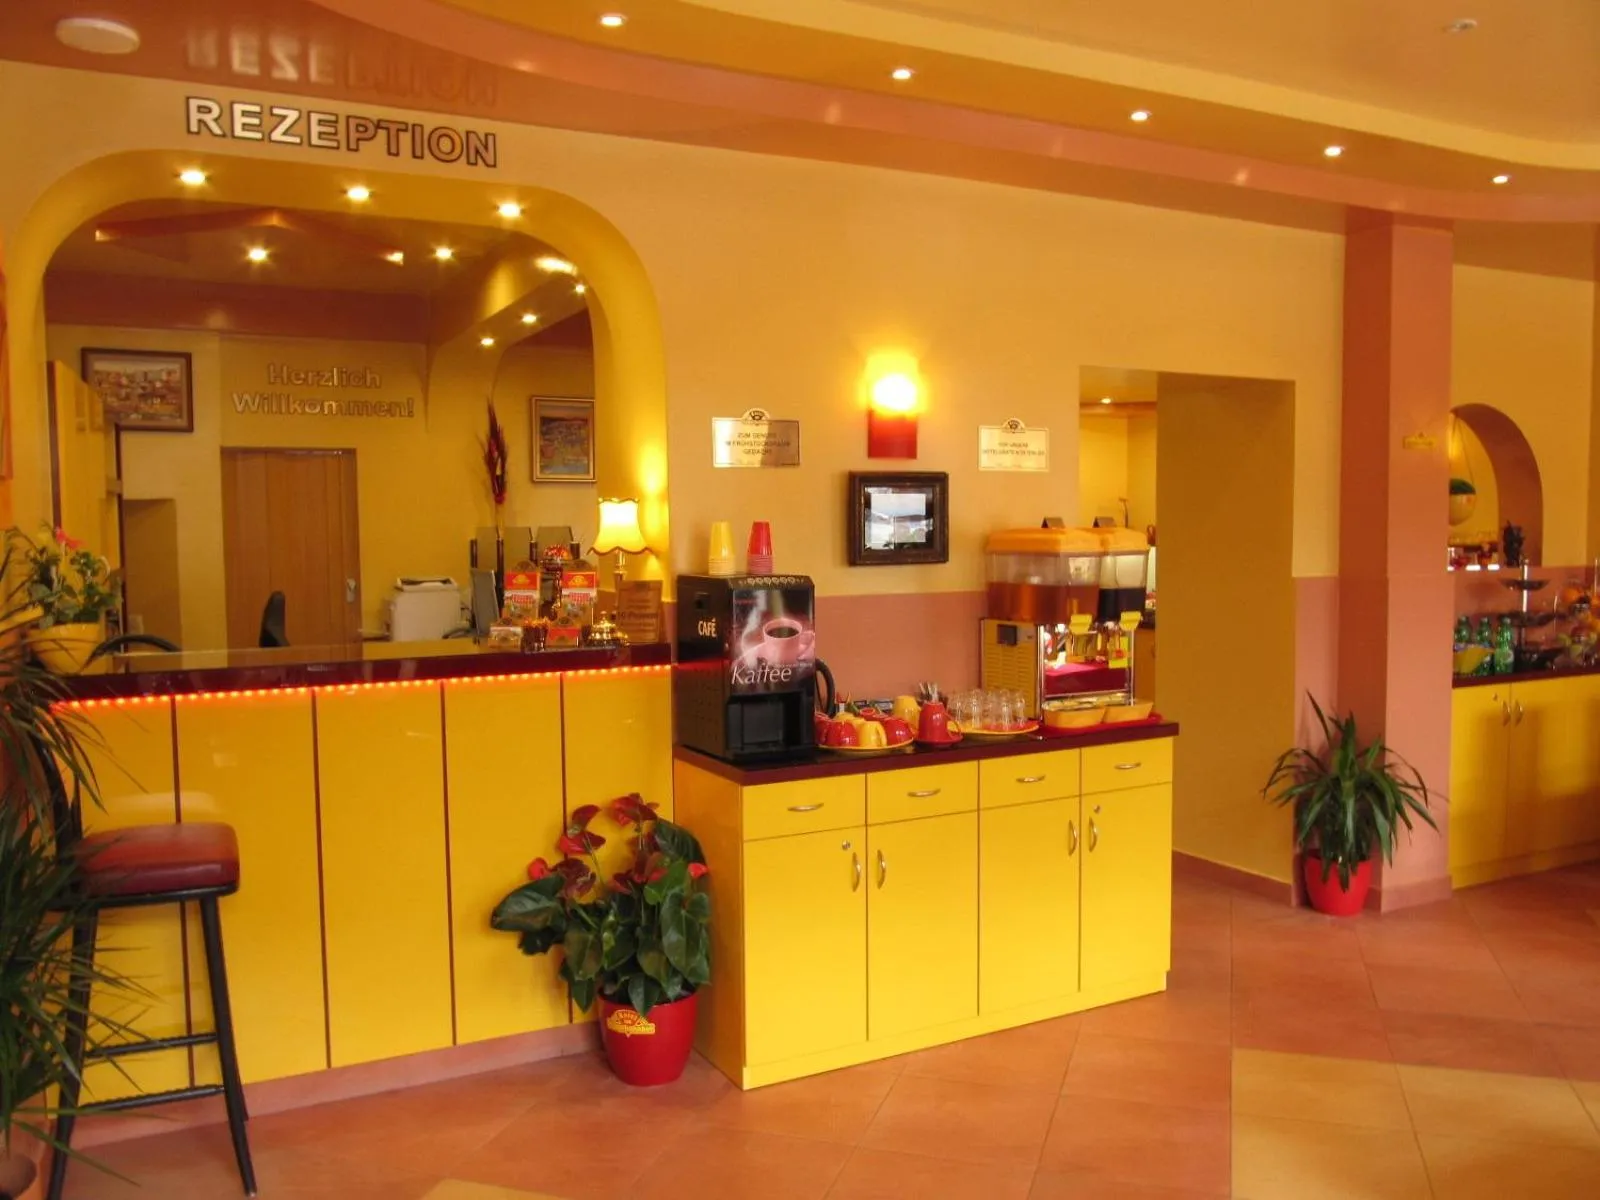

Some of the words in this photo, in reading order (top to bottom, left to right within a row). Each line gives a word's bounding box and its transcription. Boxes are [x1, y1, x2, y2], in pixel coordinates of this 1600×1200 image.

[186, 96, 498, 168] REZEPTION
[267, 363, 383, 389] Herzlich
[231, 391, 416, 419] Willkommen!
[698, 618, 717, 638] CAFÉ
[731, 658, 792, 685] Kaffee
